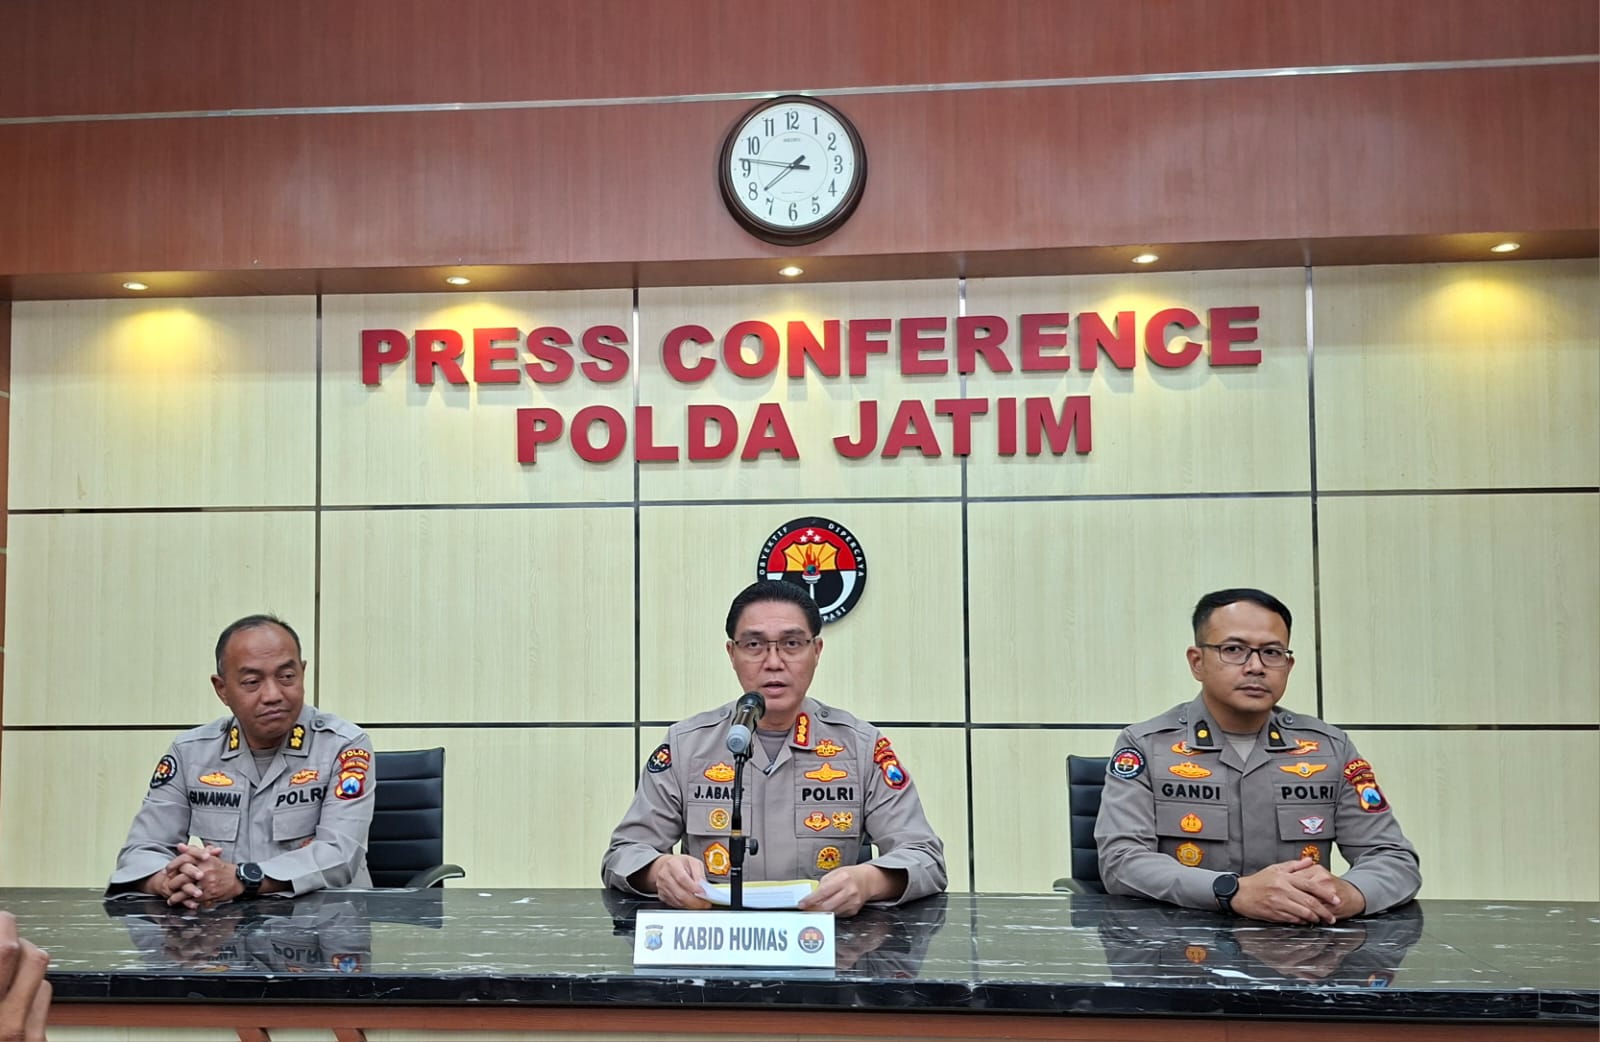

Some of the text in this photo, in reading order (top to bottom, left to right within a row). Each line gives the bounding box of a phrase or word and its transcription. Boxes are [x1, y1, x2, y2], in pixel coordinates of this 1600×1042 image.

[764, 118, 774, 137] 11
[784, 111, 800, 130] 12
[813, 117, 818, 135] 1
[747, 136, 760, 155] 10
[827, 132, 837, 151] 2
[741, 159, 751, 178] 9
[834, 155, 843, 174] 3
[748, 182, 758, 201] 8
[828, 178, 838, 197] 4
[765, 198, 774, 216] 7
[788, 203, 798, 221] 6
[812, 196, 820, 214] 5
[361, 306, 1262, 385] PRESS CONFERENCE
[517, 395, 1092, 465] POLDA JATIM
[759, 526, 788, 575] OBYEKTIF
[828, 523, 865, 577] DIPERCAYA
[802, 786, 854, 801] POLRI
[1161, 782, 1221, 800] GANDI
[1281, 785, 1334, 800] POLRI
[673, 926, 788, 952] KABID HUMAS
